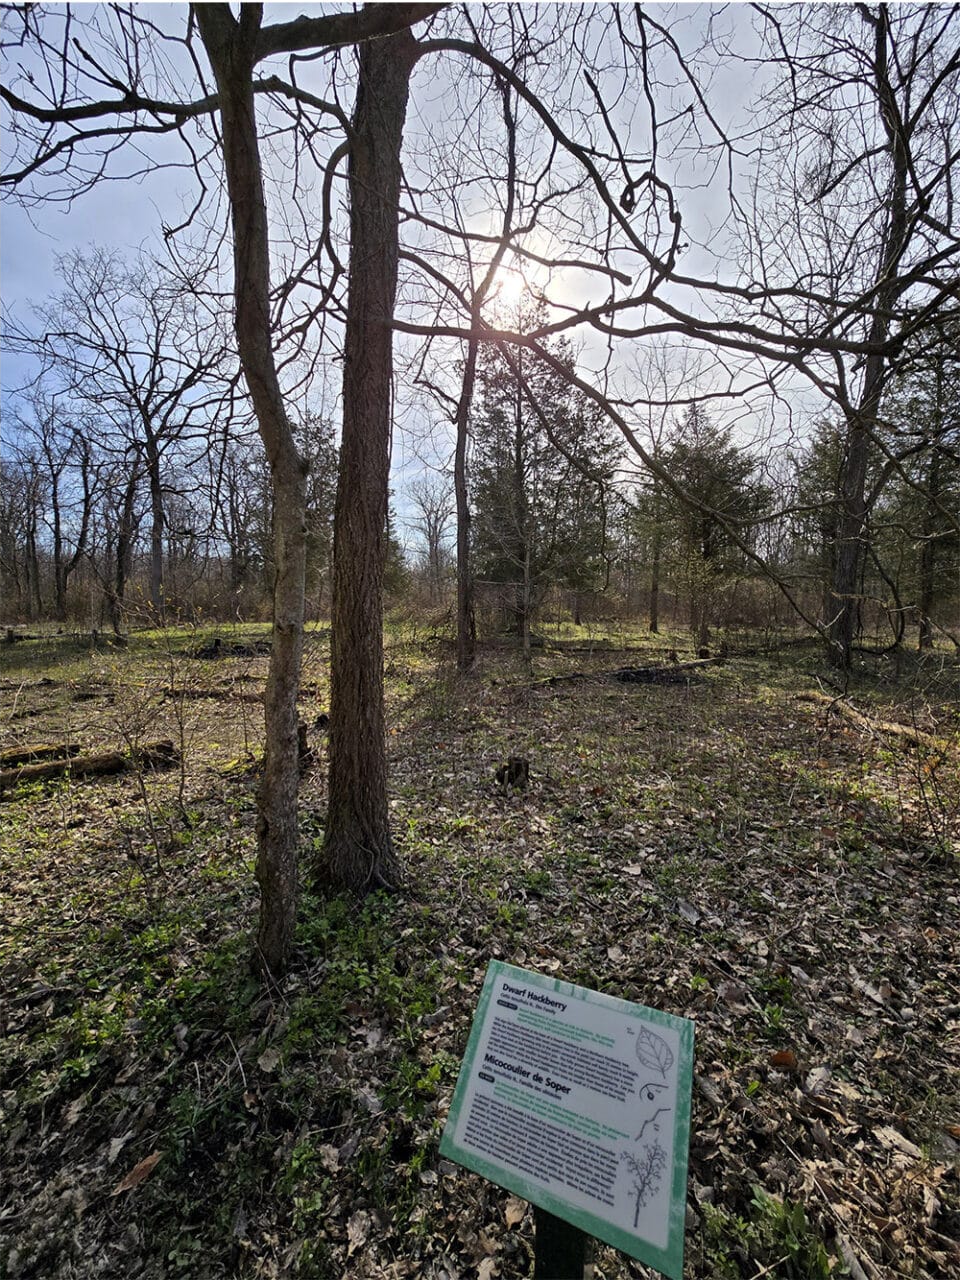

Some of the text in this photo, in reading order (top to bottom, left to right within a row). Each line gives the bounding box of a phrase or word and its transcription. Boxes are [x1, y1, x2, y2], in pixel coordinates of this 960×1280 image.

[502, 983, 527, 997] Dwarf
[527, 991, 567, 1012] Hackberry
[484, 1053, 531, 1078] Micocoulier
[532, 1072, 544, 1084] de
[545, 1077, 572, 1095] Soper
